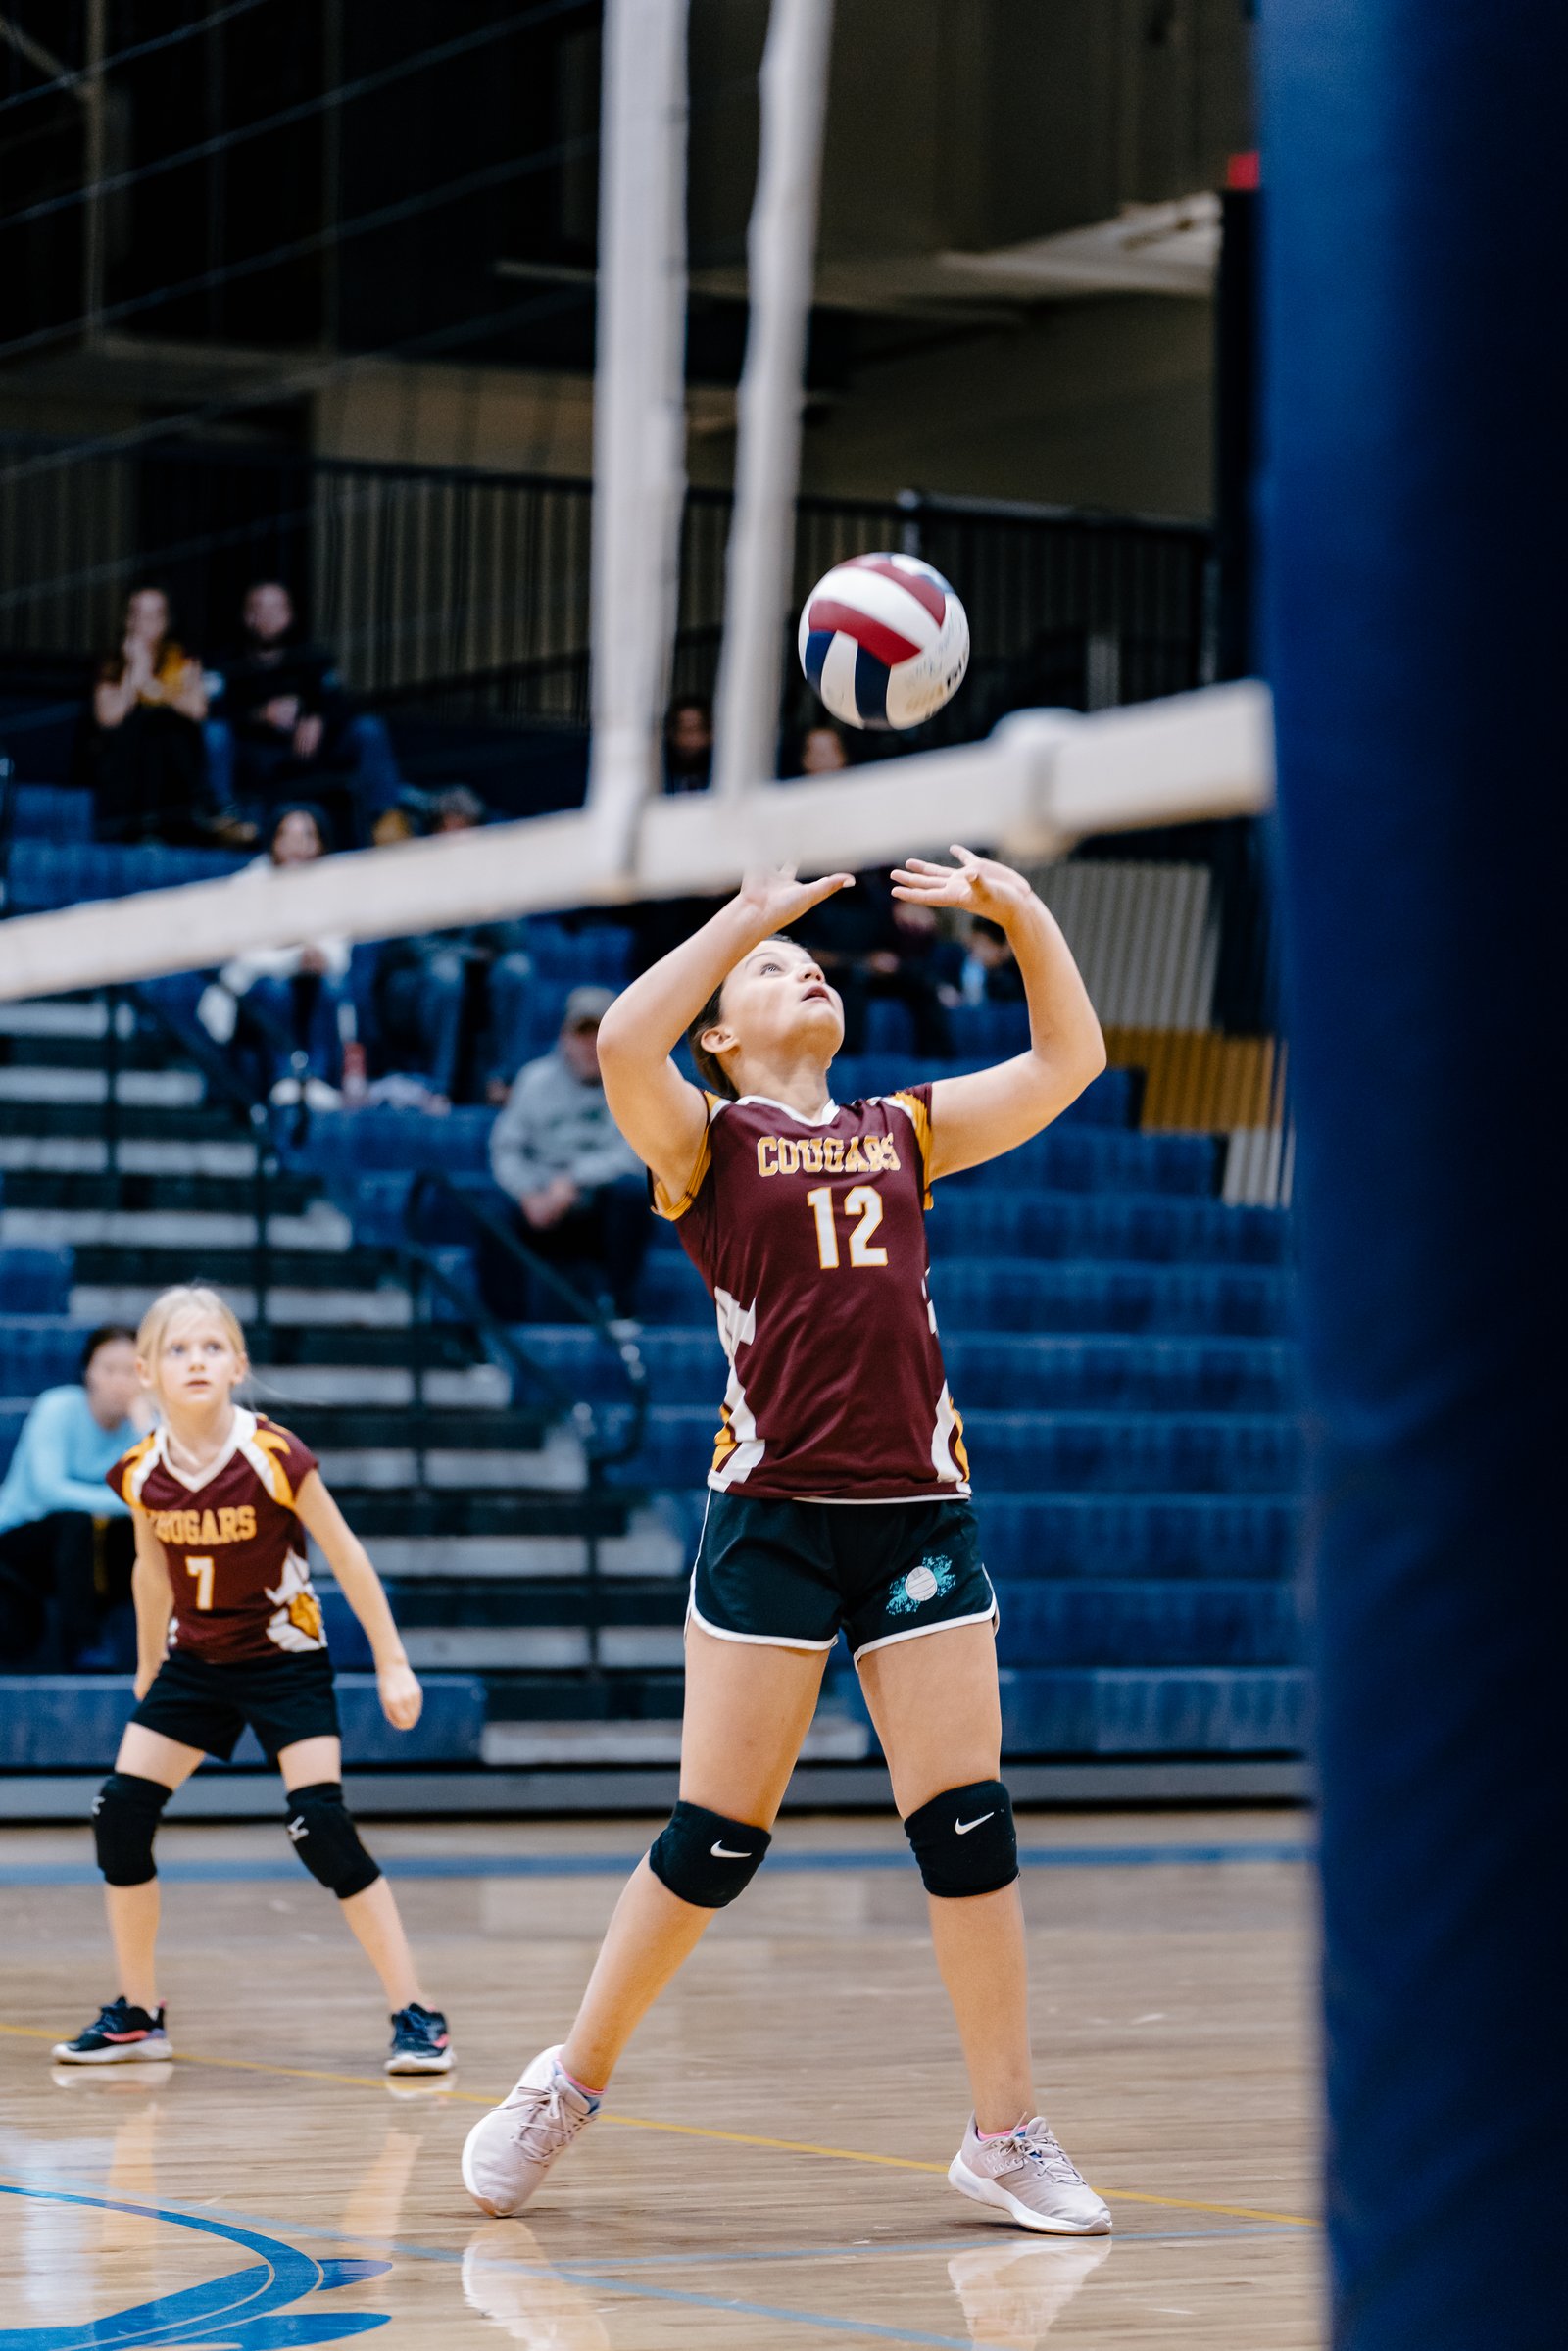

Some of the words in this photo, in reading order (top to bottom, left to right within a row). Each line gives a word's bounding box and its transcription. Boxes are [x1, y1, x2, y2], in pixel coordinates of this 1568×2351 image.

[757, 1132, 902, 1177] COUGARS
[807, 1185, 889, 1270] 12
[151, 1504, 258, 1546] OUGARS
[184, 1555, 216, 1611] 7
